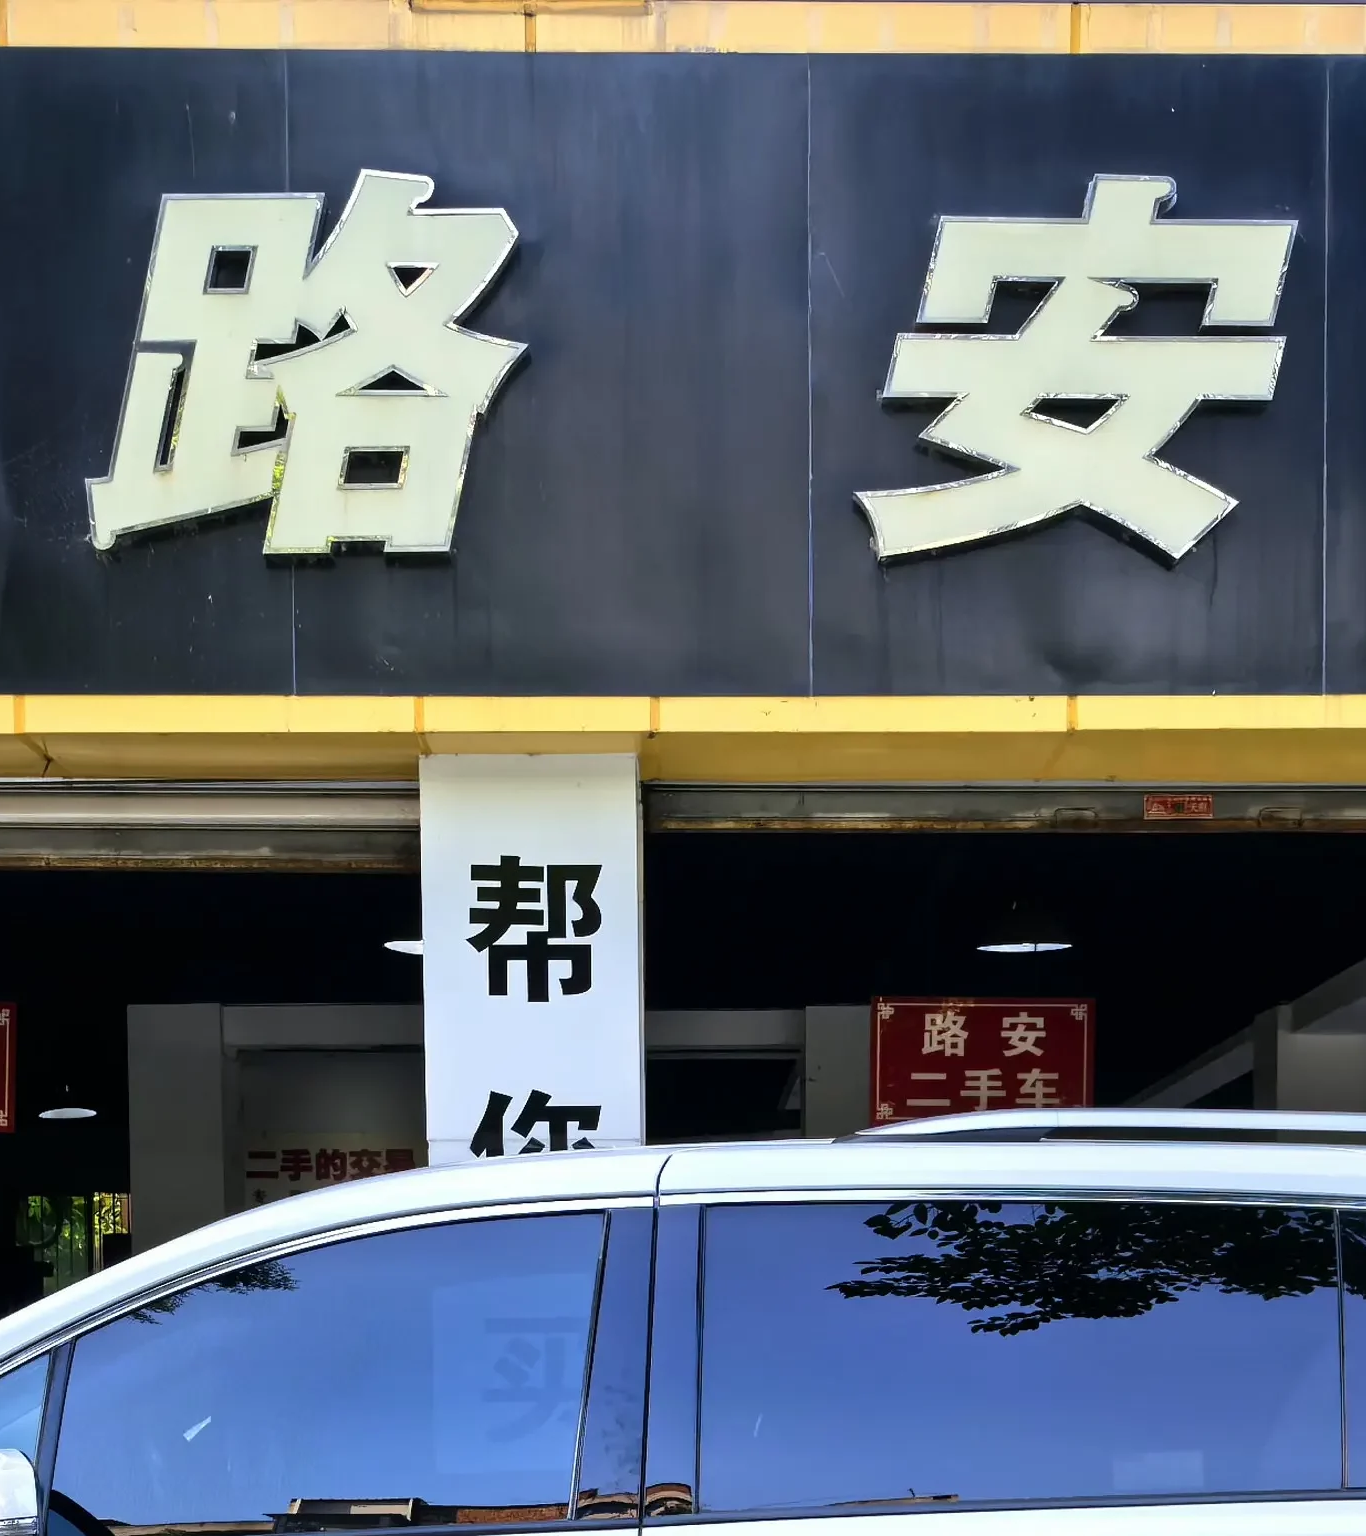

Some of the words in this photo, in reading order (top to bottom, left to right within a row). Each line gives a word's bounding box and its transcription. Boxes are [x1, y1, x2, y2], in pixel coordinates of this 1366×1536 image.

[921, 1011, 1047, 1057] 路安
[905, 1067, 1061, 1111] 二手车
